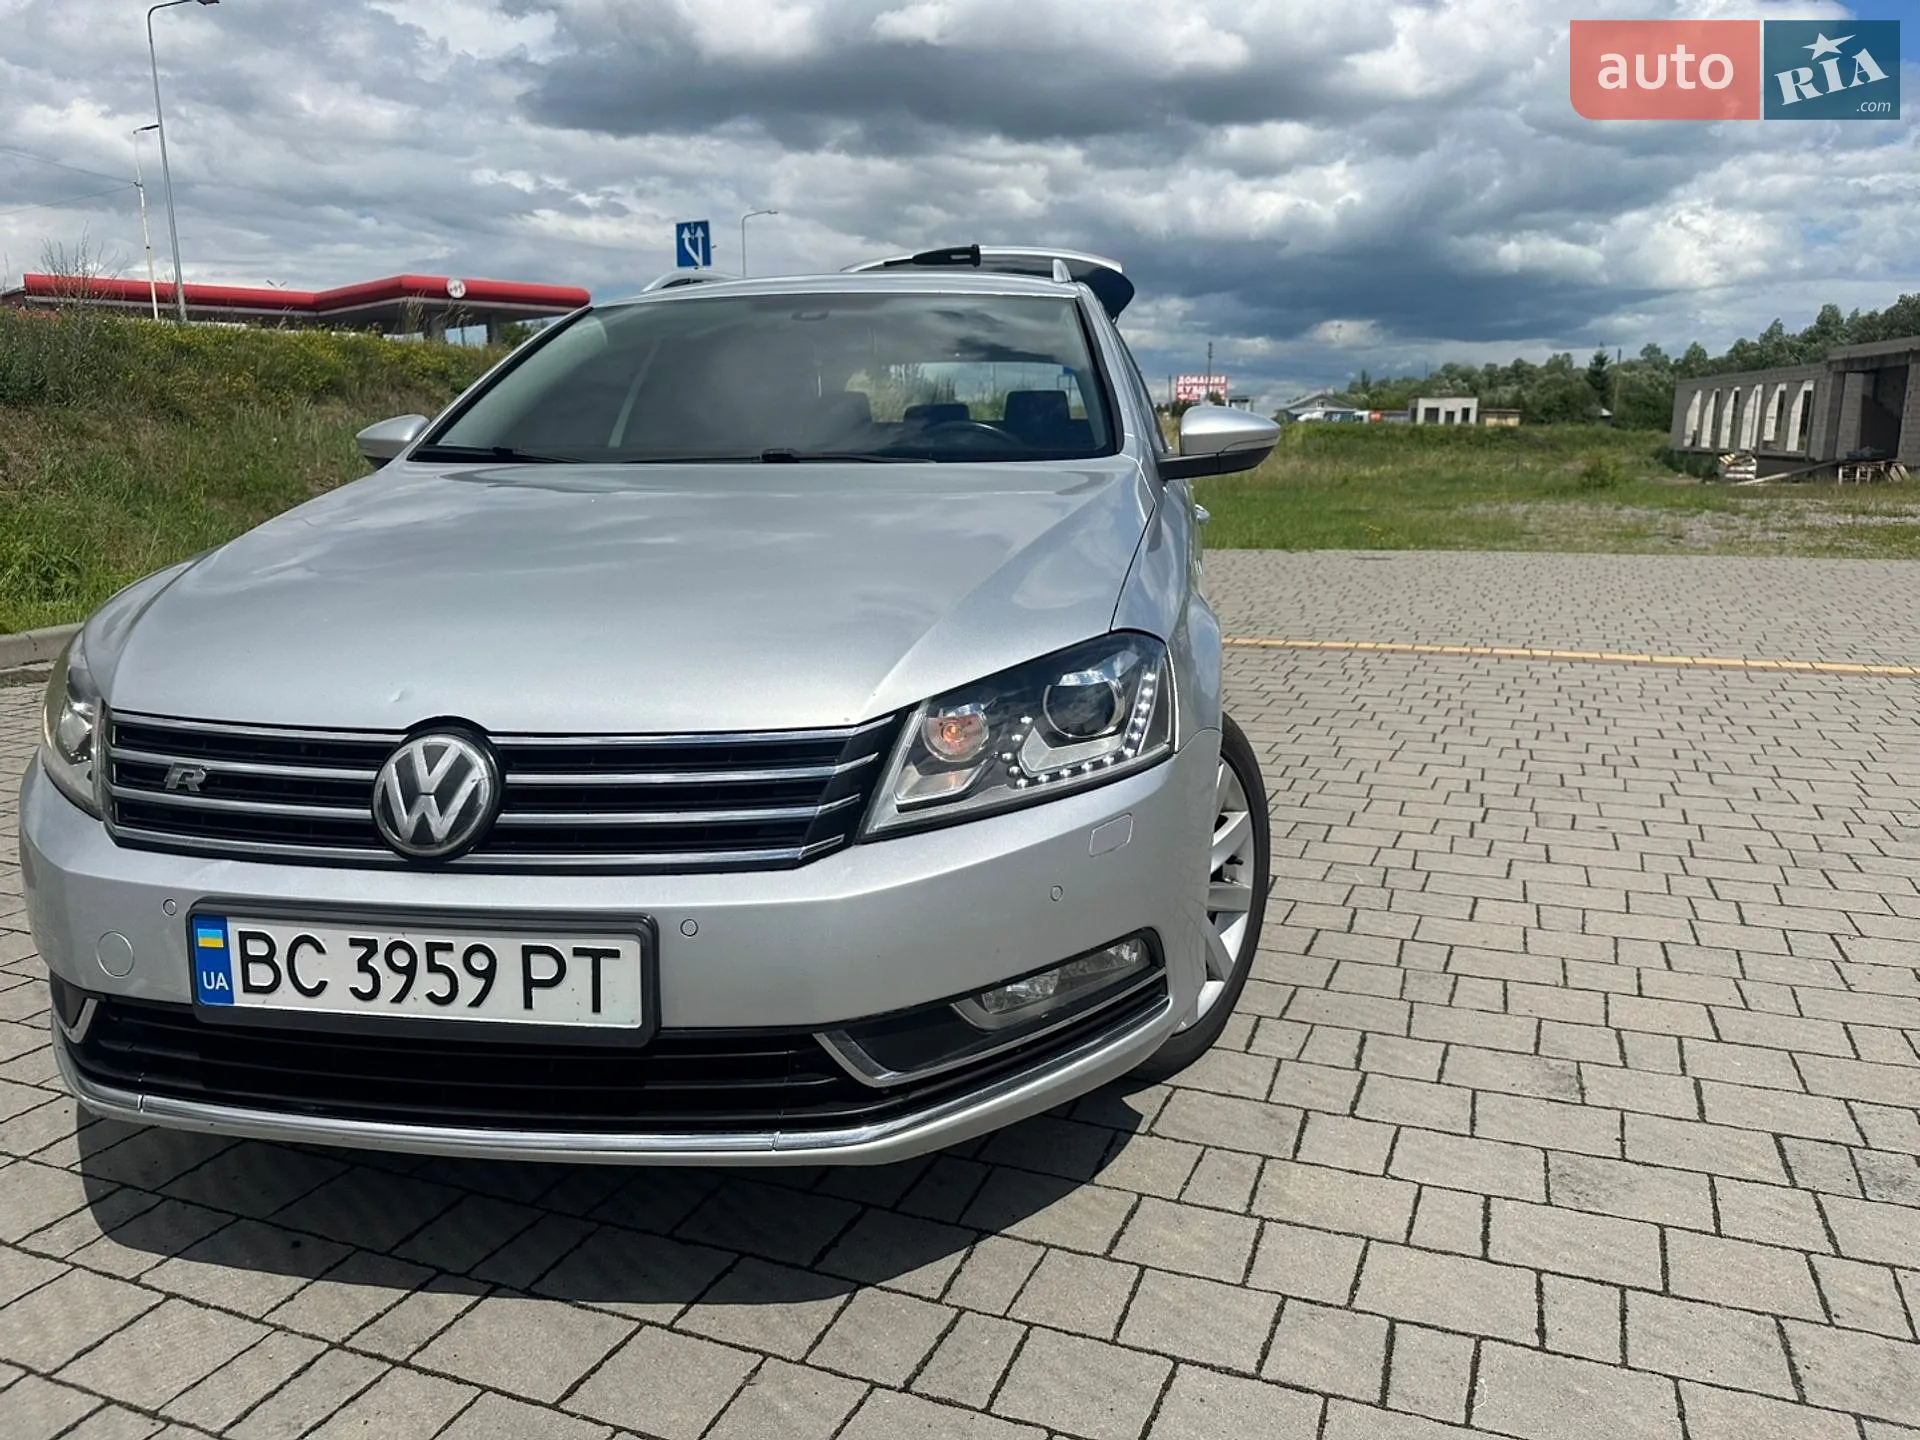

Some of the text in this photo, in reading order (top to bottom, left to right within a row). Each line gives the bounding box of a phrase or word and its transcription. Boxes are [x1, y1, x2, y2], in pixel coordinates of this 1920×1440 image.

[164, 762, 207, 792] R
[203, 971, 229, 991] UA
[237, 929, 621, 1014] BC 3959 PT
